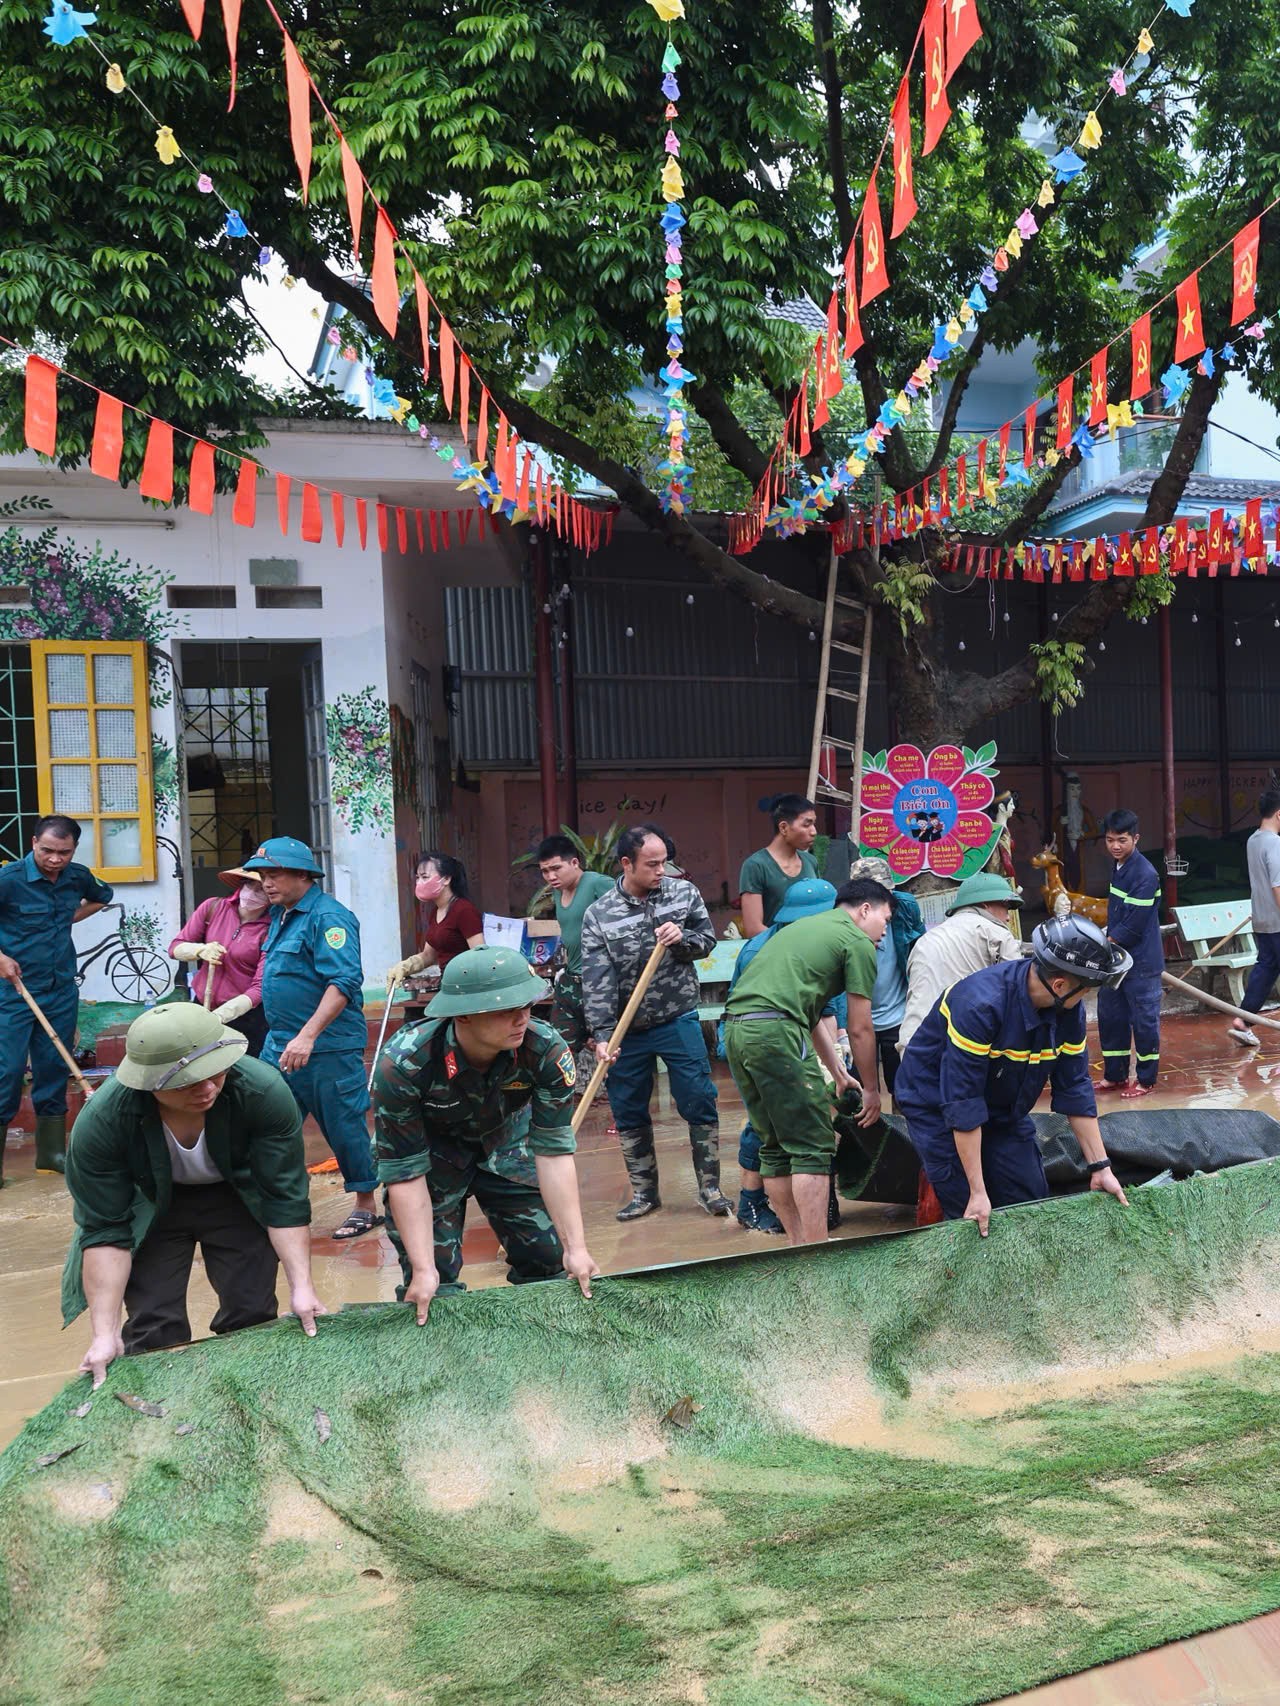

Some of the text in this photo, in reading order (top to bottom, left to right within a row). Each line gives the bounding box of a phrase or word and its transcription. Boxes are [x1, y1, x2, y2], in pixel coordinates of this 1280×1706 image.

[908, 755, 919, 763] mẹ
[933, 752, 958, 761] Ông bà
[911, 785, 939, 796] Con
[579, 793, 667, 815] ice day!
[900, 797, 950, 811] Biết Ơn
[868, 816, 884, 825] Ngày
[973, 819, 983, 827] bè
